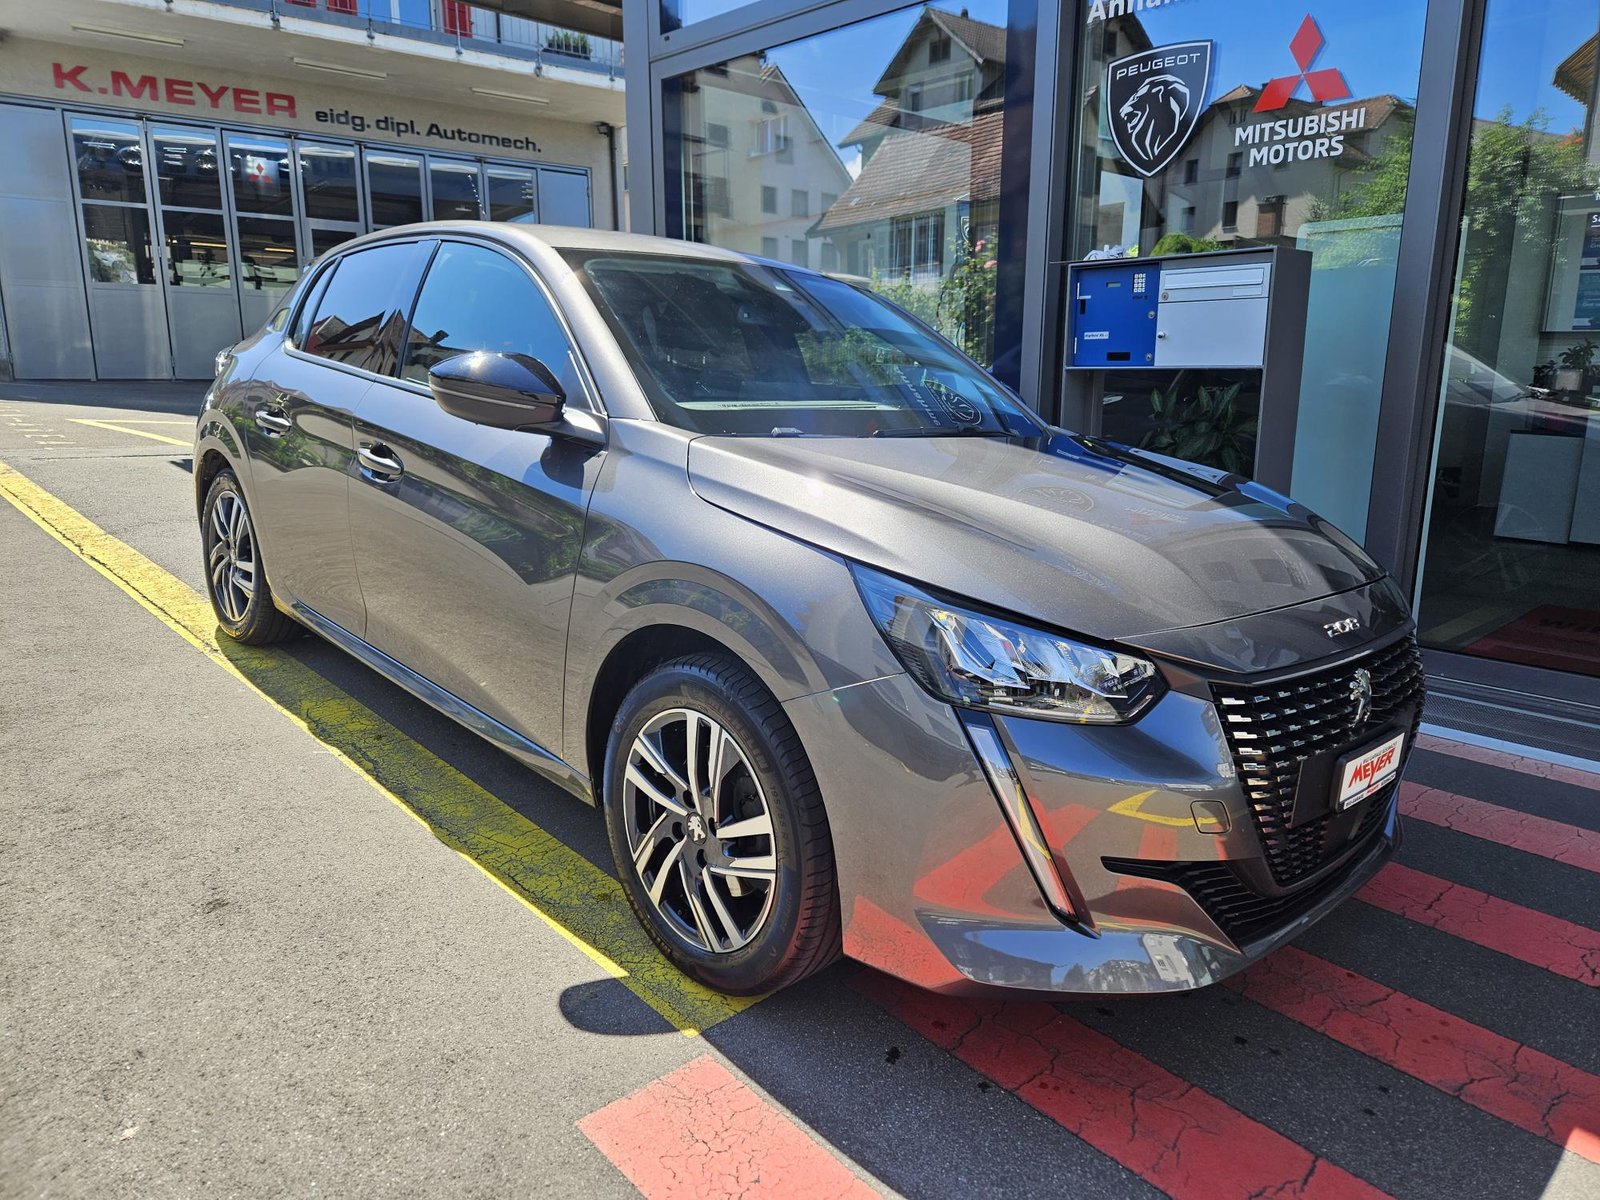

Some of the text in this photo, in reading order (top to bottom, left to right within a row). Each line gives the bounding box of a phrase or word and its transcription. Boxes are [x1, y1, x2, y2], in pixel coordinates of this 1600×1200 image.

[1116, 53, 1200, 80] PEUGEOT
[52, 63, 298, 118] K.MEYER
[315, 108, 547, 153] eidg. dipl. Automech.
[1234, 107, 1366, 147] MITSUBISHI
[1248, 135, 1344, 168] MOTORS
[1323, 617, 1360, 638] 208
[1347, 746, 1396, 788] MEYER
